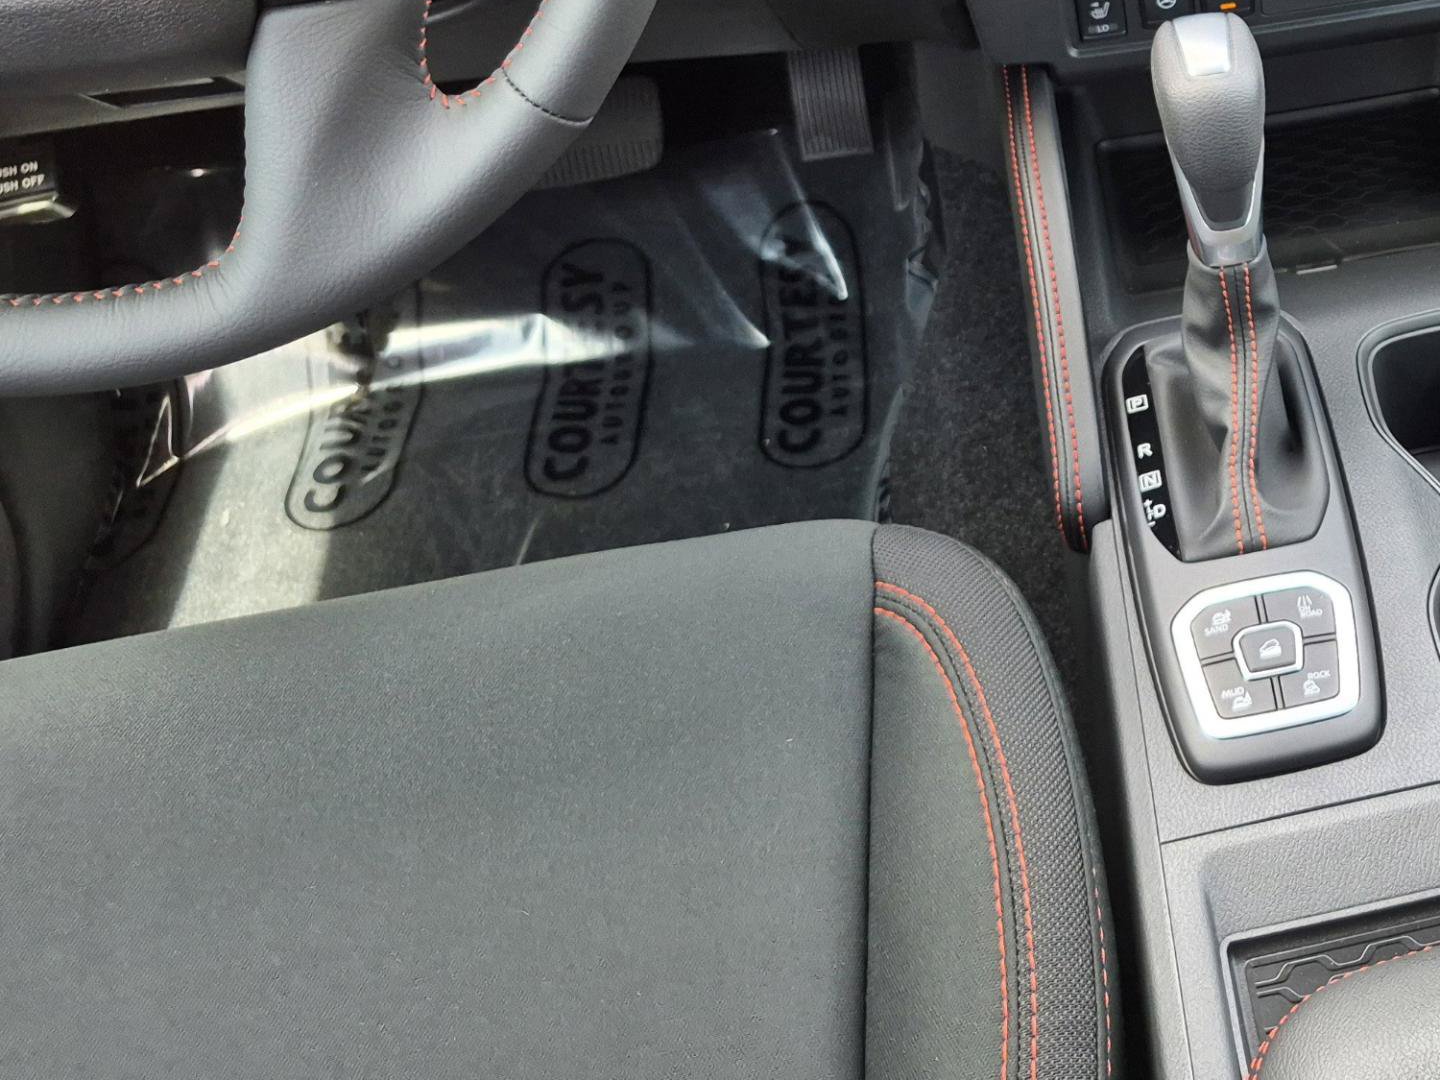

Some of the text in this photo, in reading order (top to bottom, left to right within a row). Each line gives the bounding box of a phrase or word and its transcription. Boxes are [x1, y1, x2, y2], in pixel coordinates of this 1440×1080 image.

[1096, 24, 1110, 33] LO
[0, 160, 39, 178] SH ON
[22, 173, 45, 189] OFF
[544, 263, 603, 481] COURTSY
[1137, 442, 1153, 459] R
[1153, 503, 1166, 519] D
[1300, 609, 1323, 618] ROAD
[1204, 624, 1229, 636] SAND
[1307, 670, 1331, 680] ROCK
[1221, 686, 1245, 699] MUD
